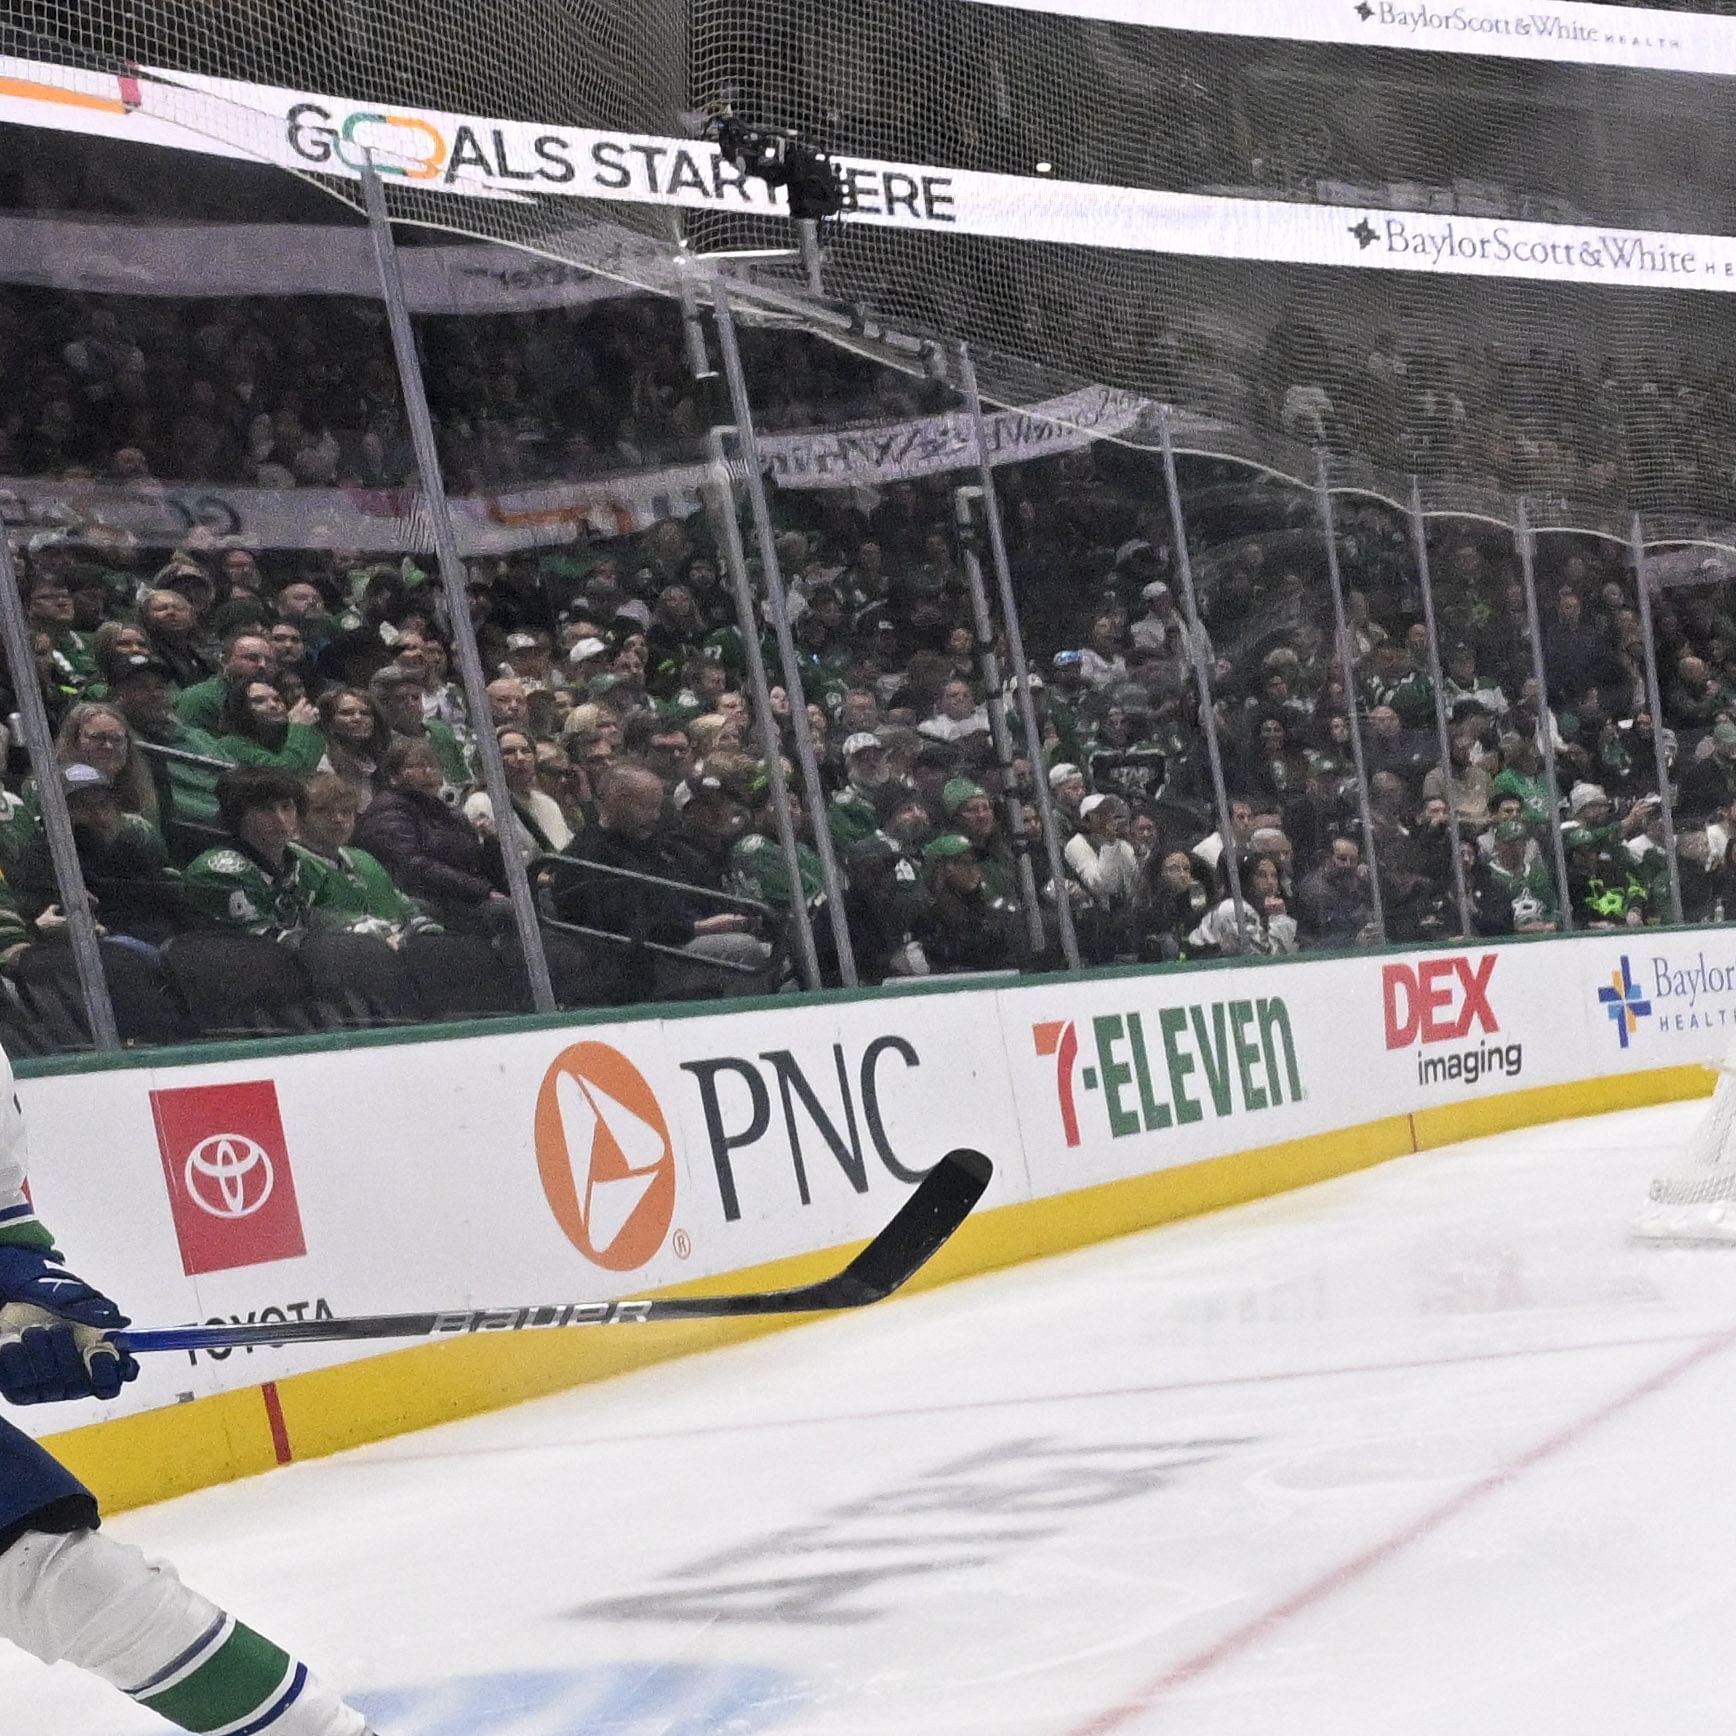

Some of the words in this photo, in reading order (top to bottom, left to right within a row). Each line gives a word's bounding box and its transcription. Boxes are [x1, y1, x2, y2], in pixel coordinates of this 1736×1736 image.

[1382, 952, 1502, 1051] DEX
[1418, 1040, 1523, 1086] imaging
[679, 1034, 946, 1223] PNC
